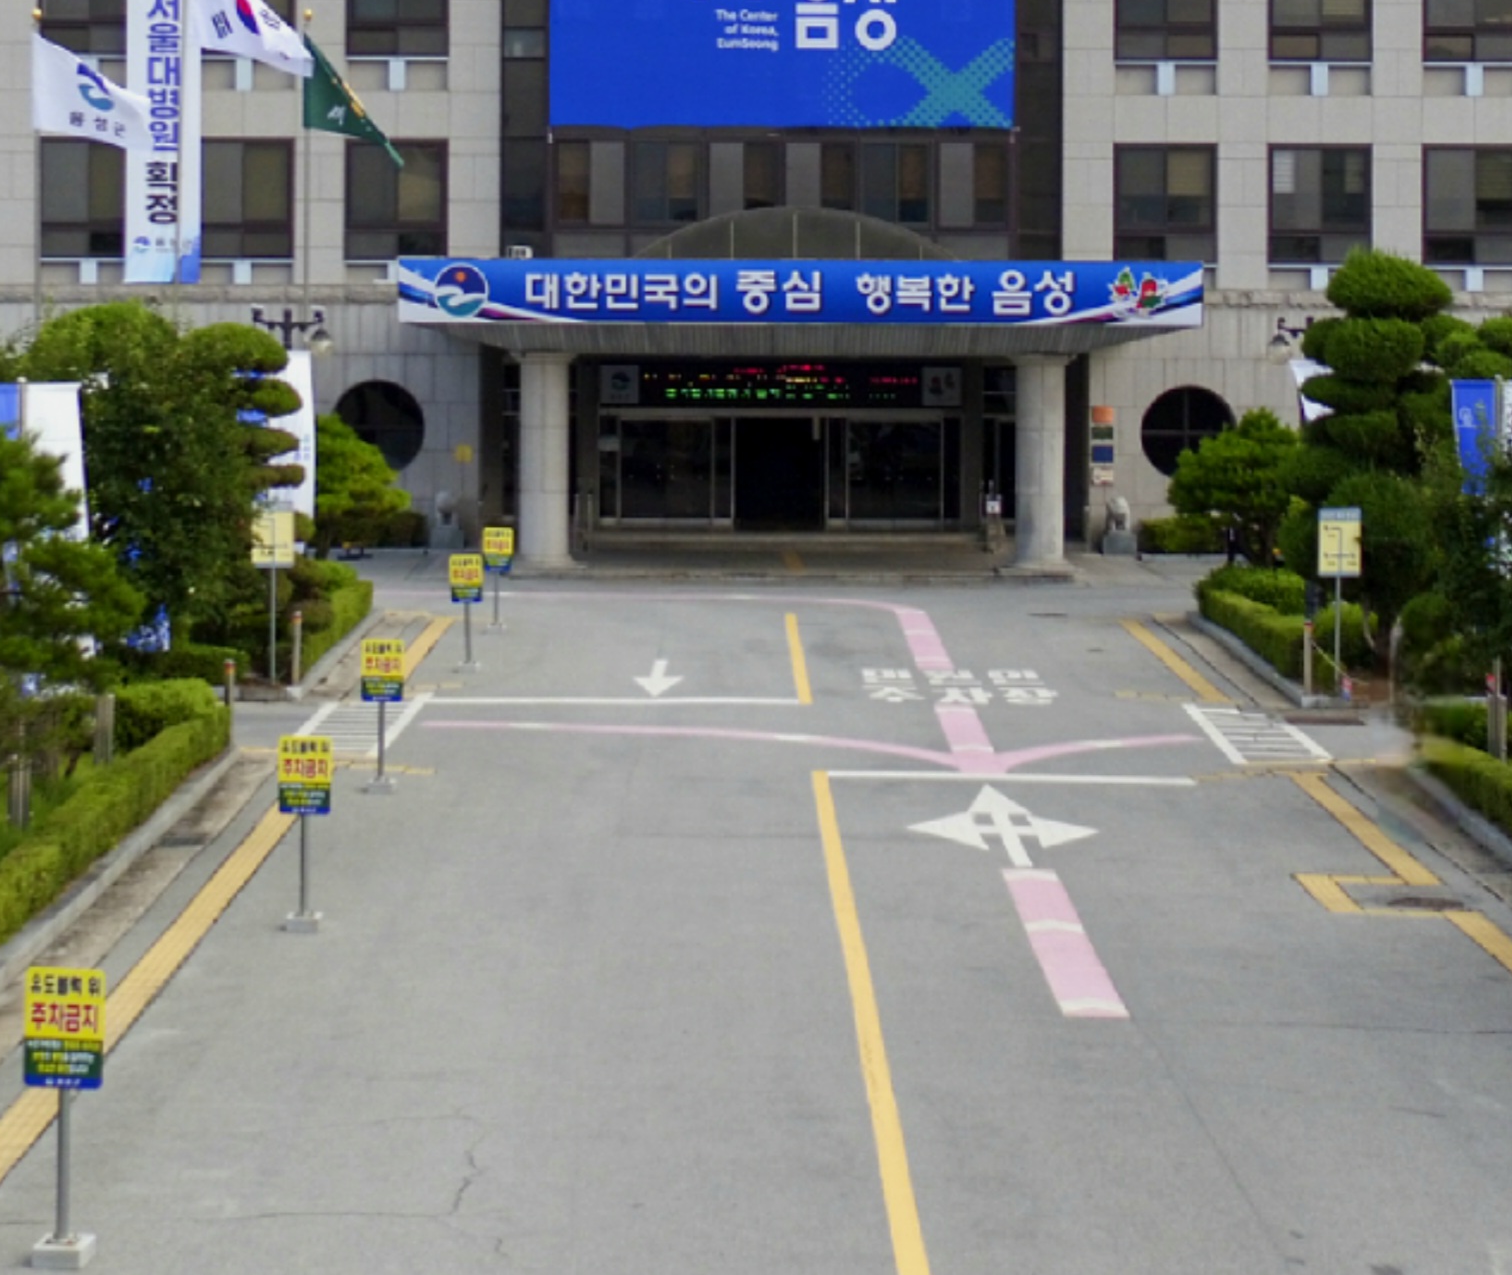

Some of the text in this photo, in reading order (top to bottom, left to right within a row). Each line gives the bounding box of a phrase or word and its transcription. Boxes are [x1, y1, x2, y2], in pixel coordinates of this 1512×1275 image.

[145, 161, 178, 225] 확정
[524, 269, 1079, 316] 대한민국의 중심 행복한 음성
[31, 1002, 99, 1034] 주차금지
